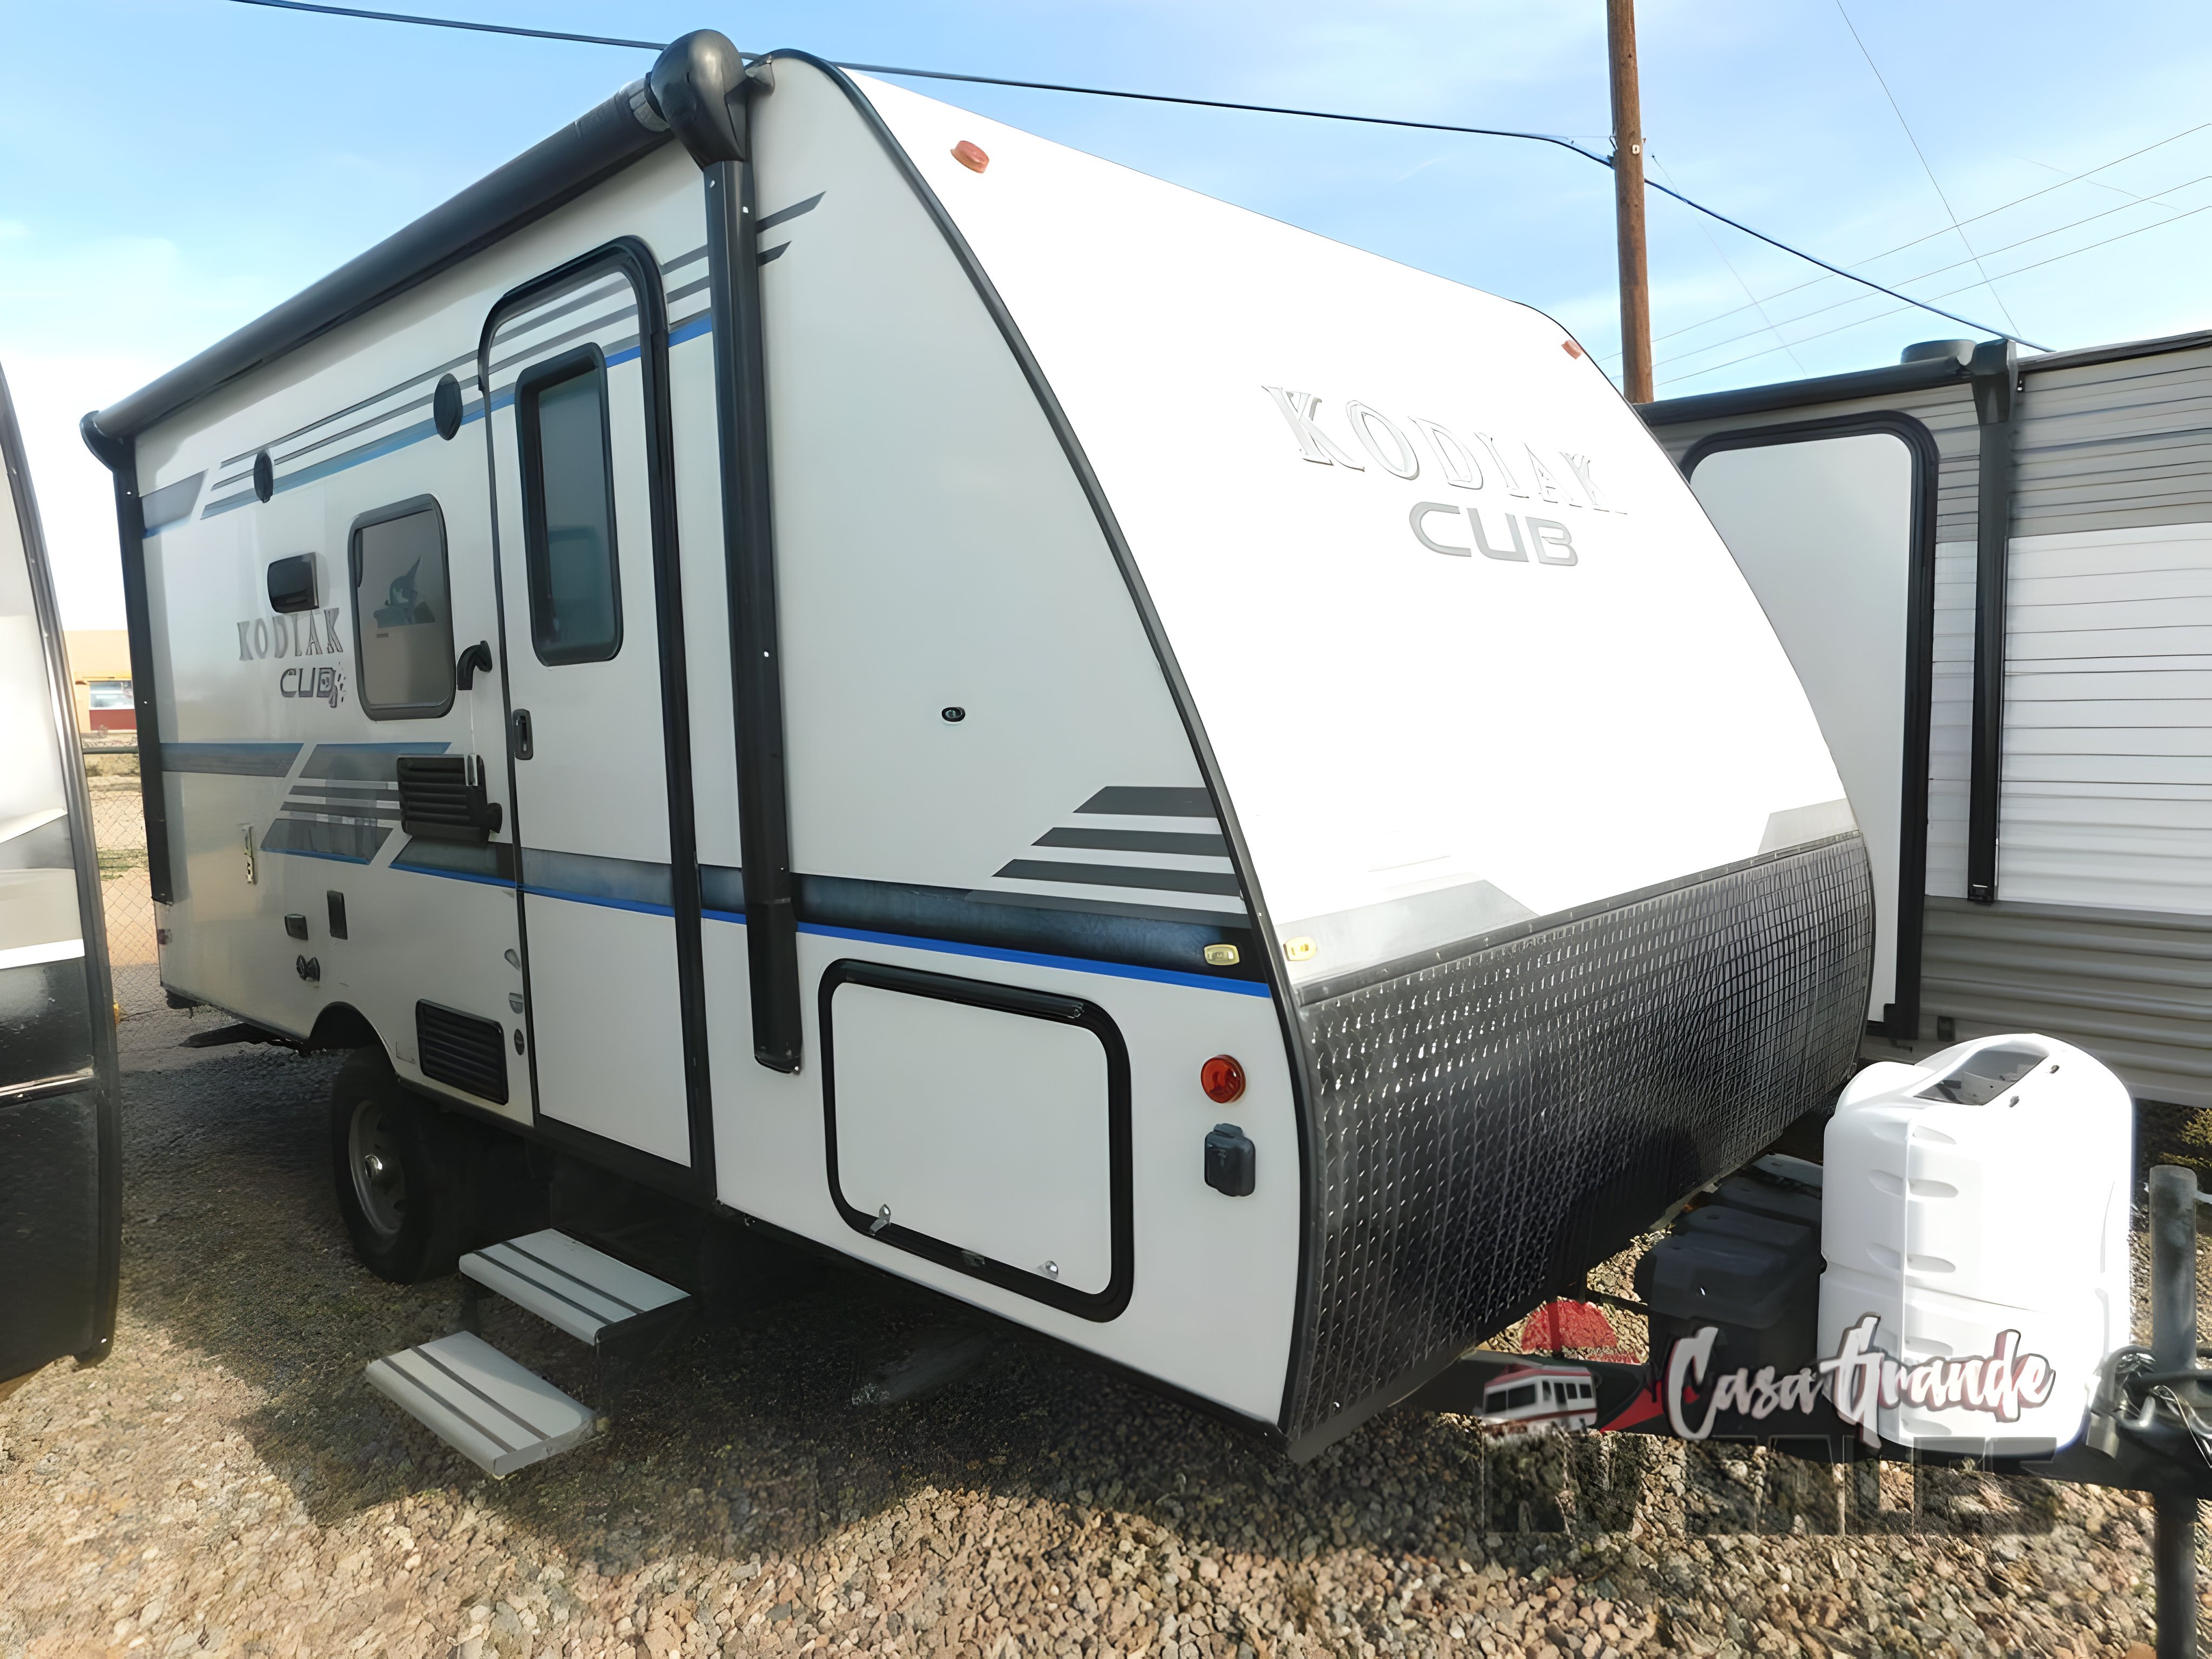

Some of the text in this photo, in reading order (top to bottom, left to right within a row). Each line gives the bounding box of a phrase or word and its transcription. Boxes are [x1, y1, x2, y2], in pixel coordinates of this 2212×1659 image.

[1262, 386, 1627, 514] KODIAK
[1409, 502, 1578, 566] CUB
[237, 608, 343, 661] KODIAK
